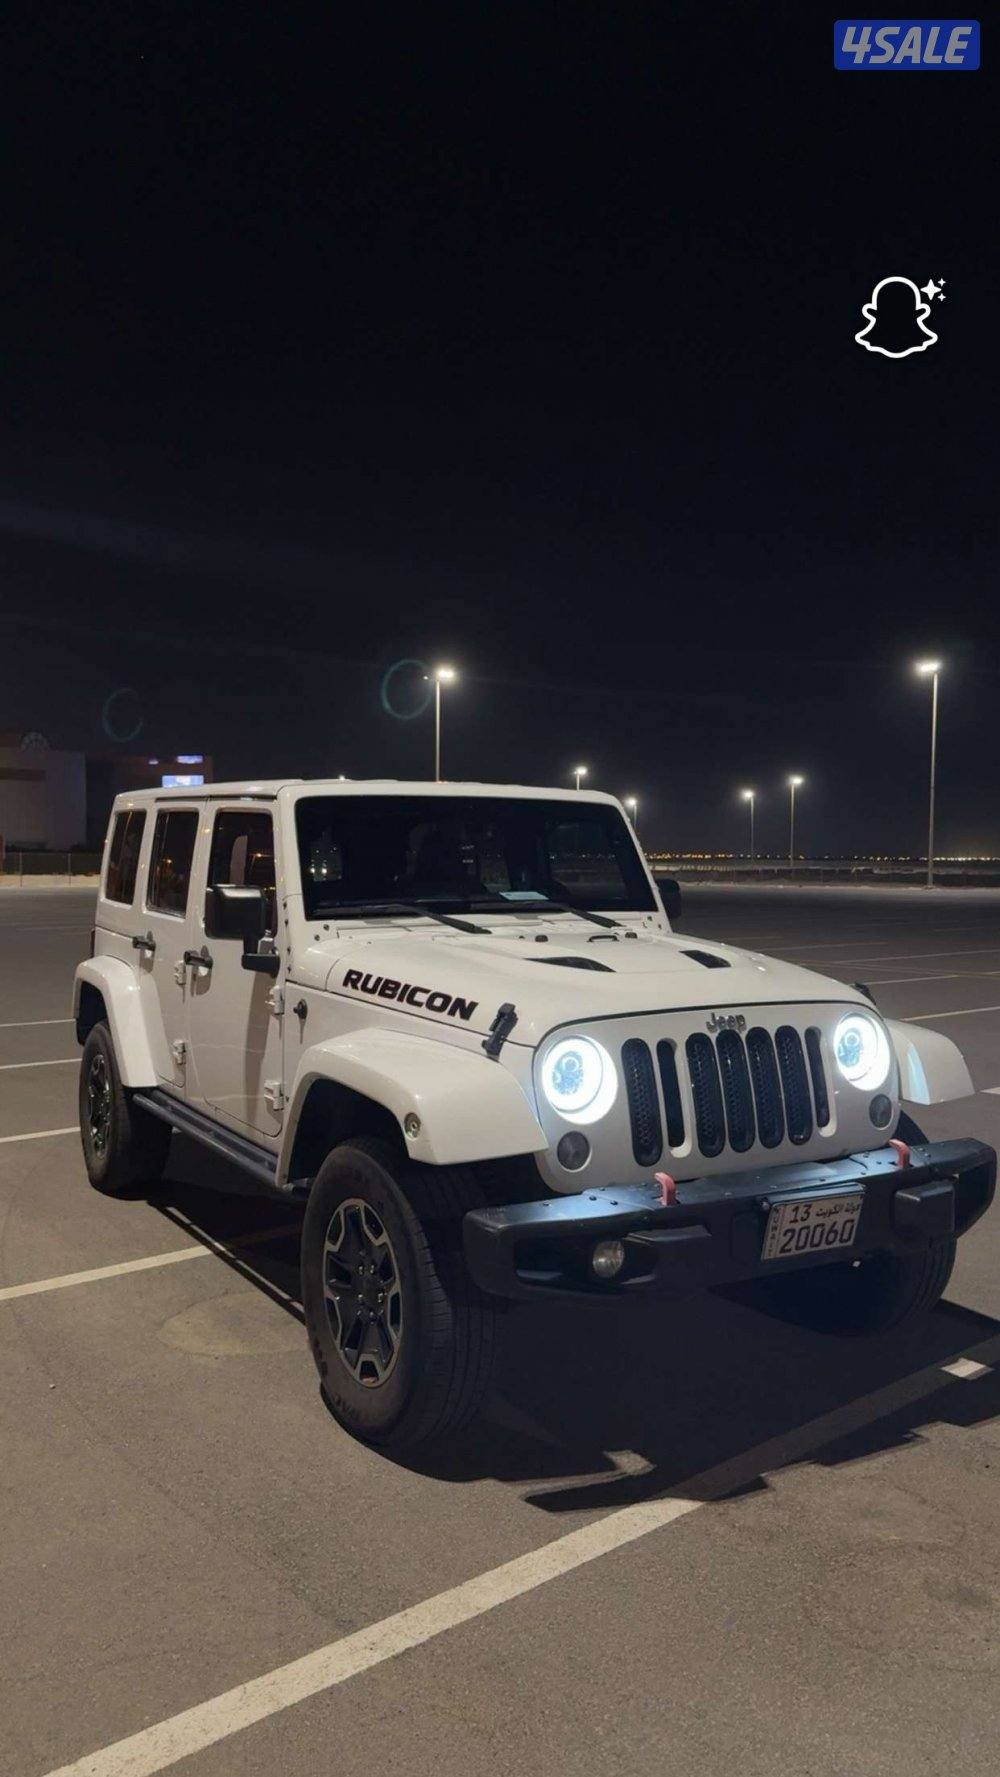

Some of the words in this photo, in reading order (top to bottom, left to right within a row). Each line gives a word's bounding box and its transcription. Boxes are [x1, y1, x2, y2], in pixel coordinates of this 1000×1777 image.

[342, 968, 479, 1021] RUBICON
[706, 1012, 747, 1033] Jeep
[788, 1204, 812, 1224] 13
[779, 1219, 855, 1254] 20060
